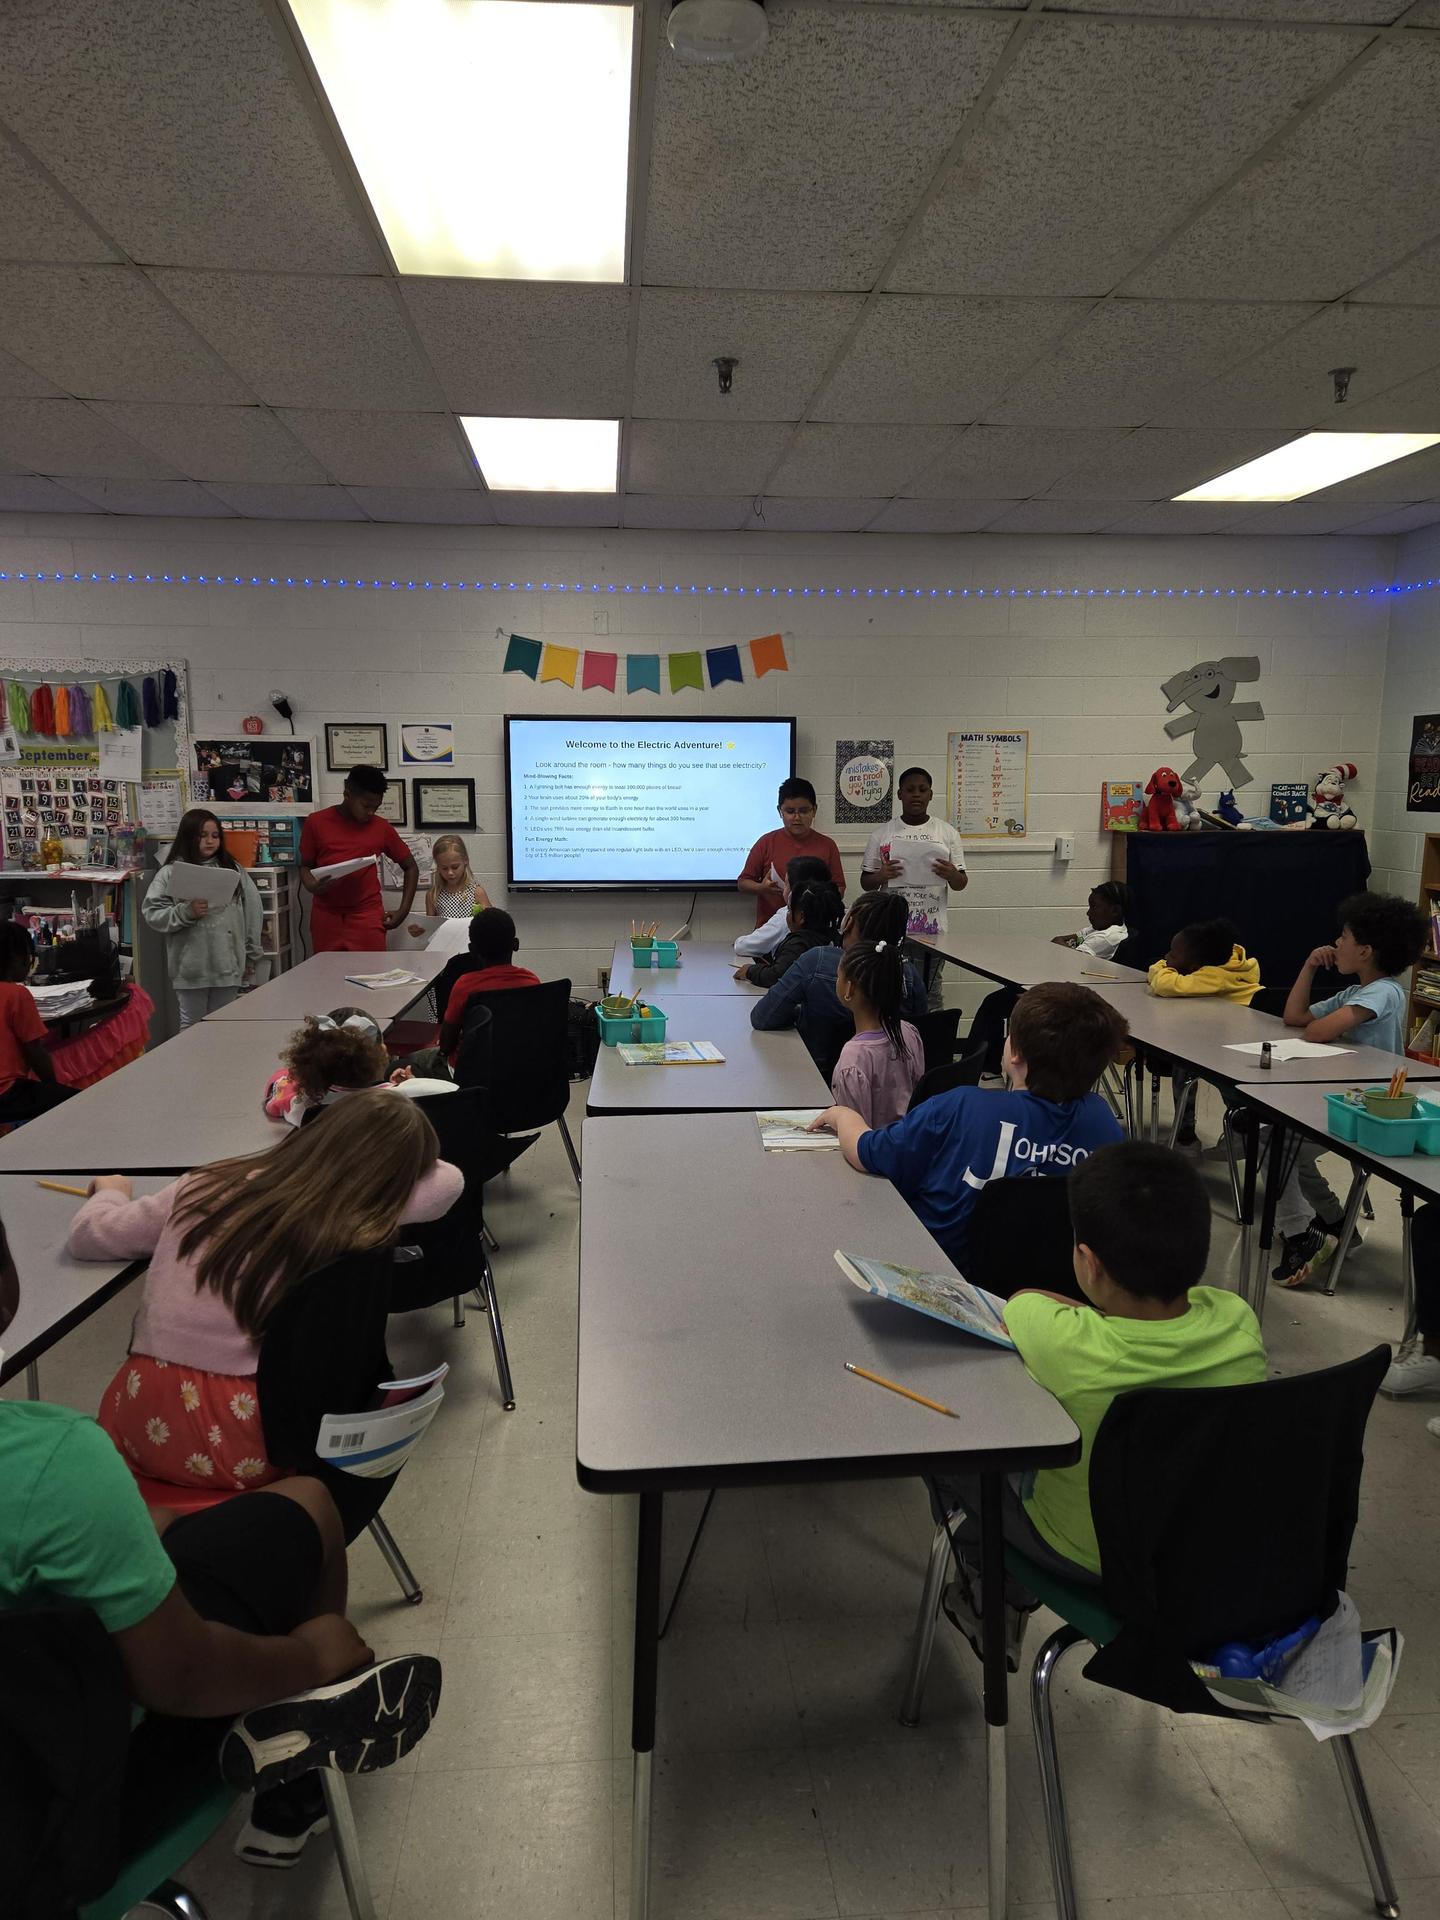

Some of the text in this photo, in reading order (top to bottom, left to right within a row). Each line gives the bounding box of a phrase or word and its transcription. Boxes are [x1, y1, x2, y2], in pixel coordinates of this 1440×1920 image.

[961, 734, 1022, 743] MATH SYMBOLS
[566, 740, 607, 748] Welcome
[621, 740, 635, 748] the
[638, 740, 671, 749] Electric
[674, 740, 722, 750] Adventure!
[19, 749, 90, 764] September
[648, 762, 666, 770] things
[732, 762, 767, 771] electricity?
[846, 762, 878, 774] mistakes
[863, 768, 884, 784] proof
[41, 781, 46, 790] 2
[92, 781, 98, 790] 5
[847, 782, 862, 796] you
[860, 786, 882, 802] trying
[26, 797, 32, 806] 8
[42, 796, 48, 804] 9
[58, 798, 66, 806] 10
[76, 796, 84, 806] 11
[43, 812, 52, 820] 16
[56, 812, 64, 821] 17
[74, 812, 82, 820] 18
[93, 812, 102, 820] 19
[108, 812, 116, 820] 20
[26, 828, 34, 837] 22
[60, 826, 69, 834] 24
[74, 828, 84, 836] 25
